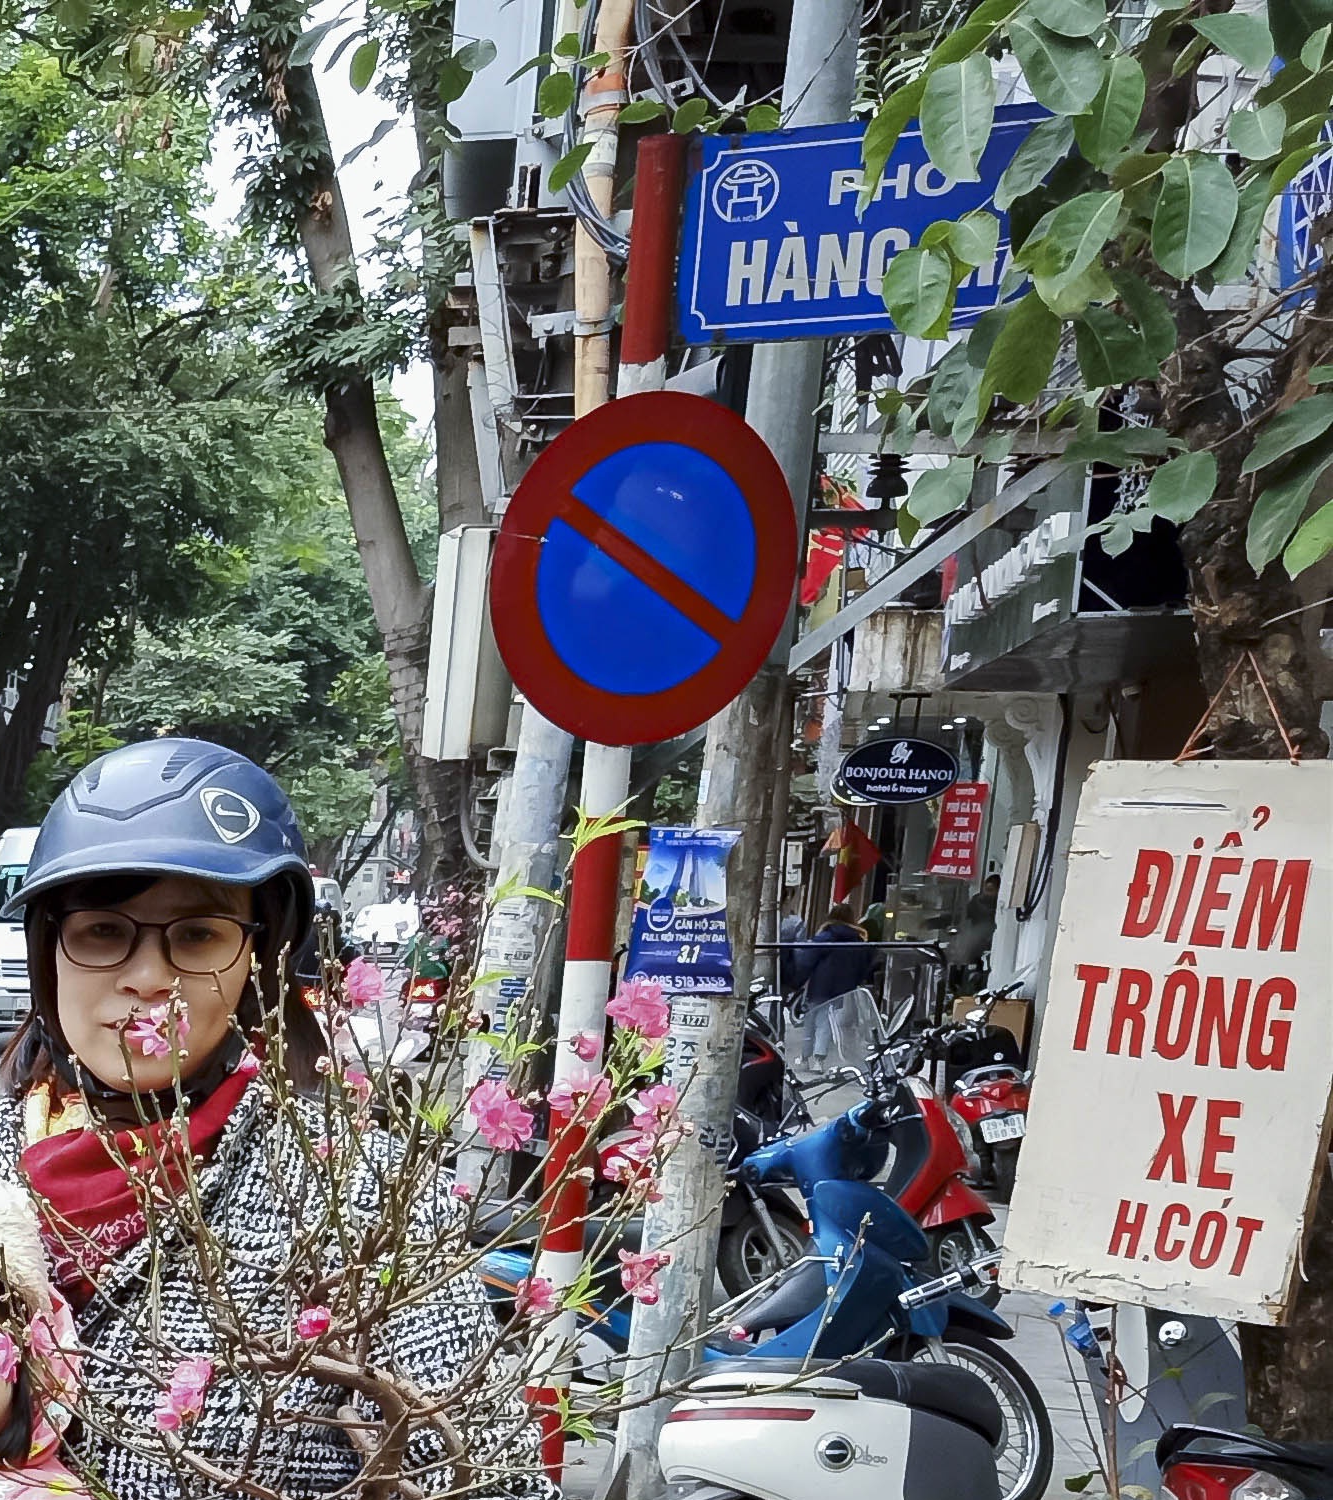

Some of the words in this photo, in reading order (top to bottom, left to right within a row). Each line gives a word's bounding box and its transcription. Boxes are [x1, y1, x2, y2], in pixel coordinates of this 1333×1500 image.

[845, 766, 907, 781] BONJOUR
[908, 768, 953, 781] HANOI
[677, 945, 700, 964] 3.1
[1073, 951, 1297, 1071] TRÔNG
[1146, 1092, 1242, 1191] XE
[1107, 1197, 1264, 1276] H.CÓT
